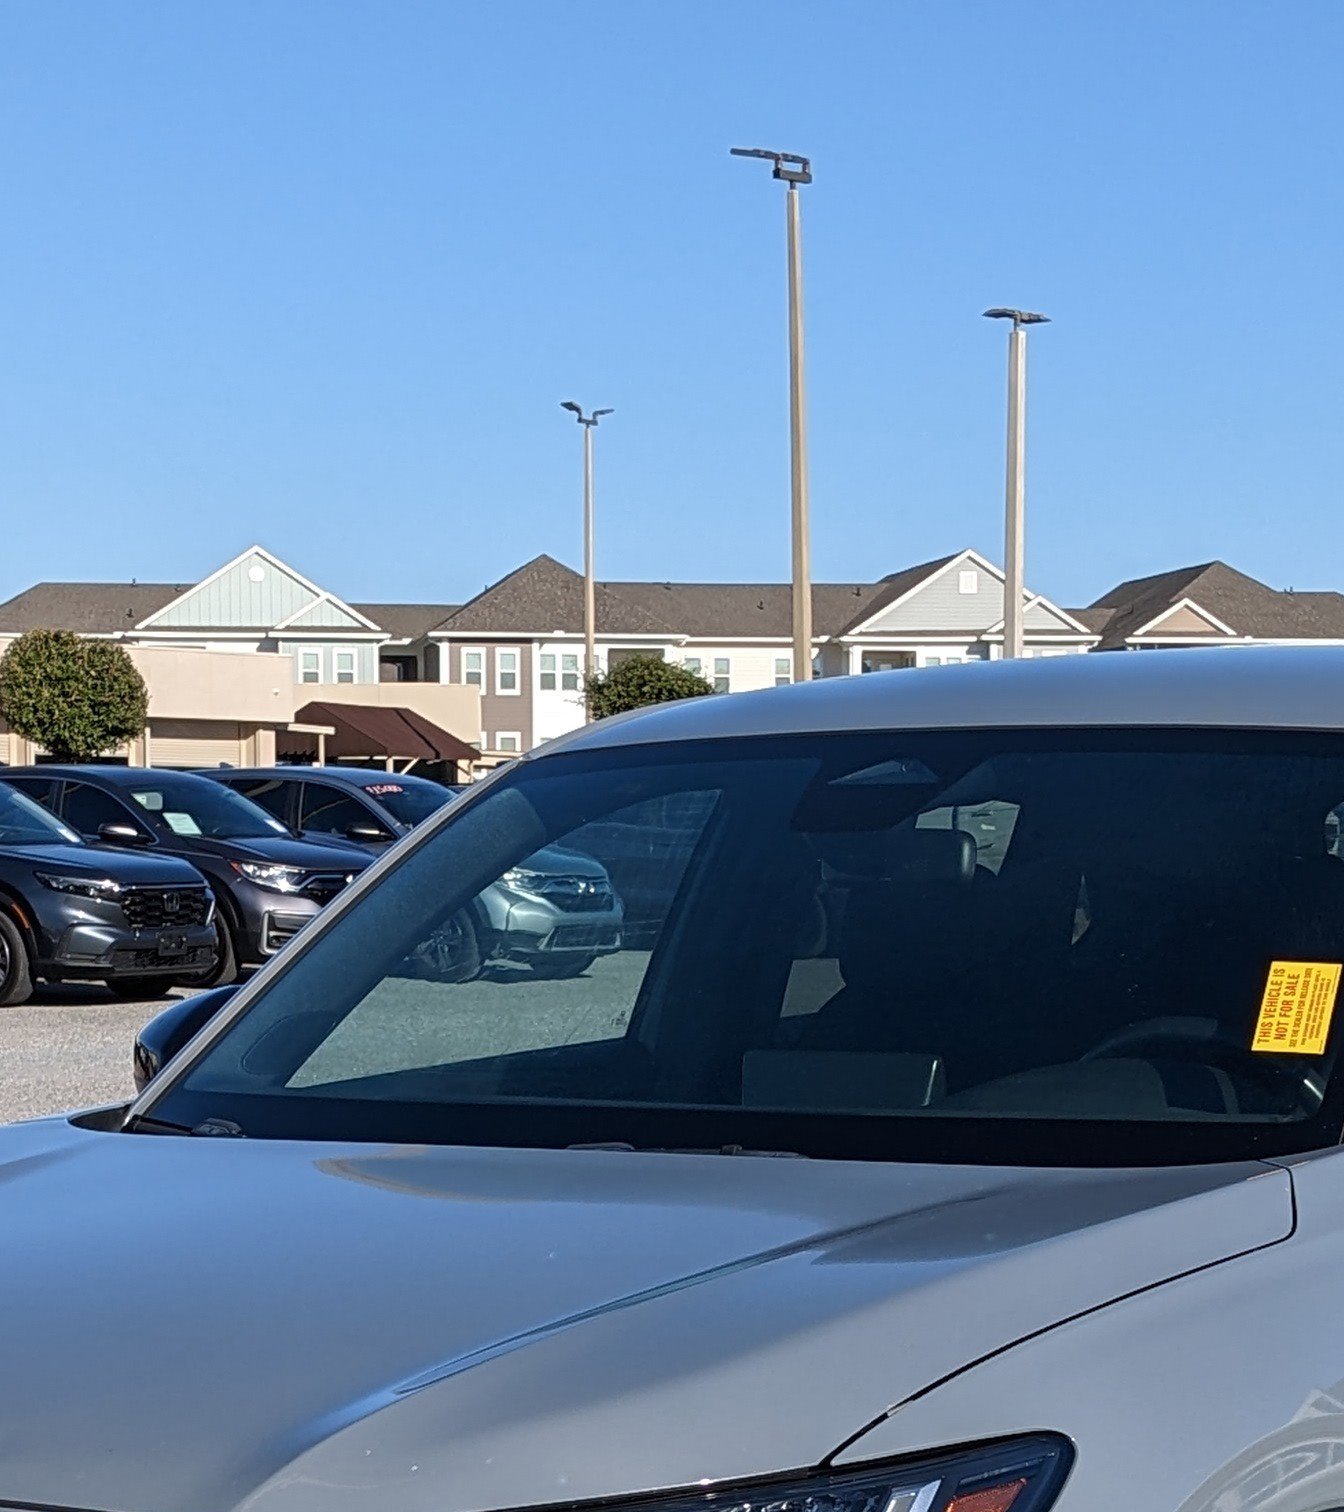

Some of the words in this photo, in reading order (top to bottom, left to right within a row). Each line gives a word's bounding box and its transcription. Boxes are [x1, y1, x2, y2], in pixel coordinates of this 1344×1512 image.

[1272, 968, 1286, 977] IS
[1284, 973, 1300, 996] SALE
[1262, 979, 1283, 1019] VEHICLE
[1279, 999, 1294, 1018] FOR
[1257, 1021, 1273, 1044] THIS
[1274, 1020, 1289, 1040] NOT
